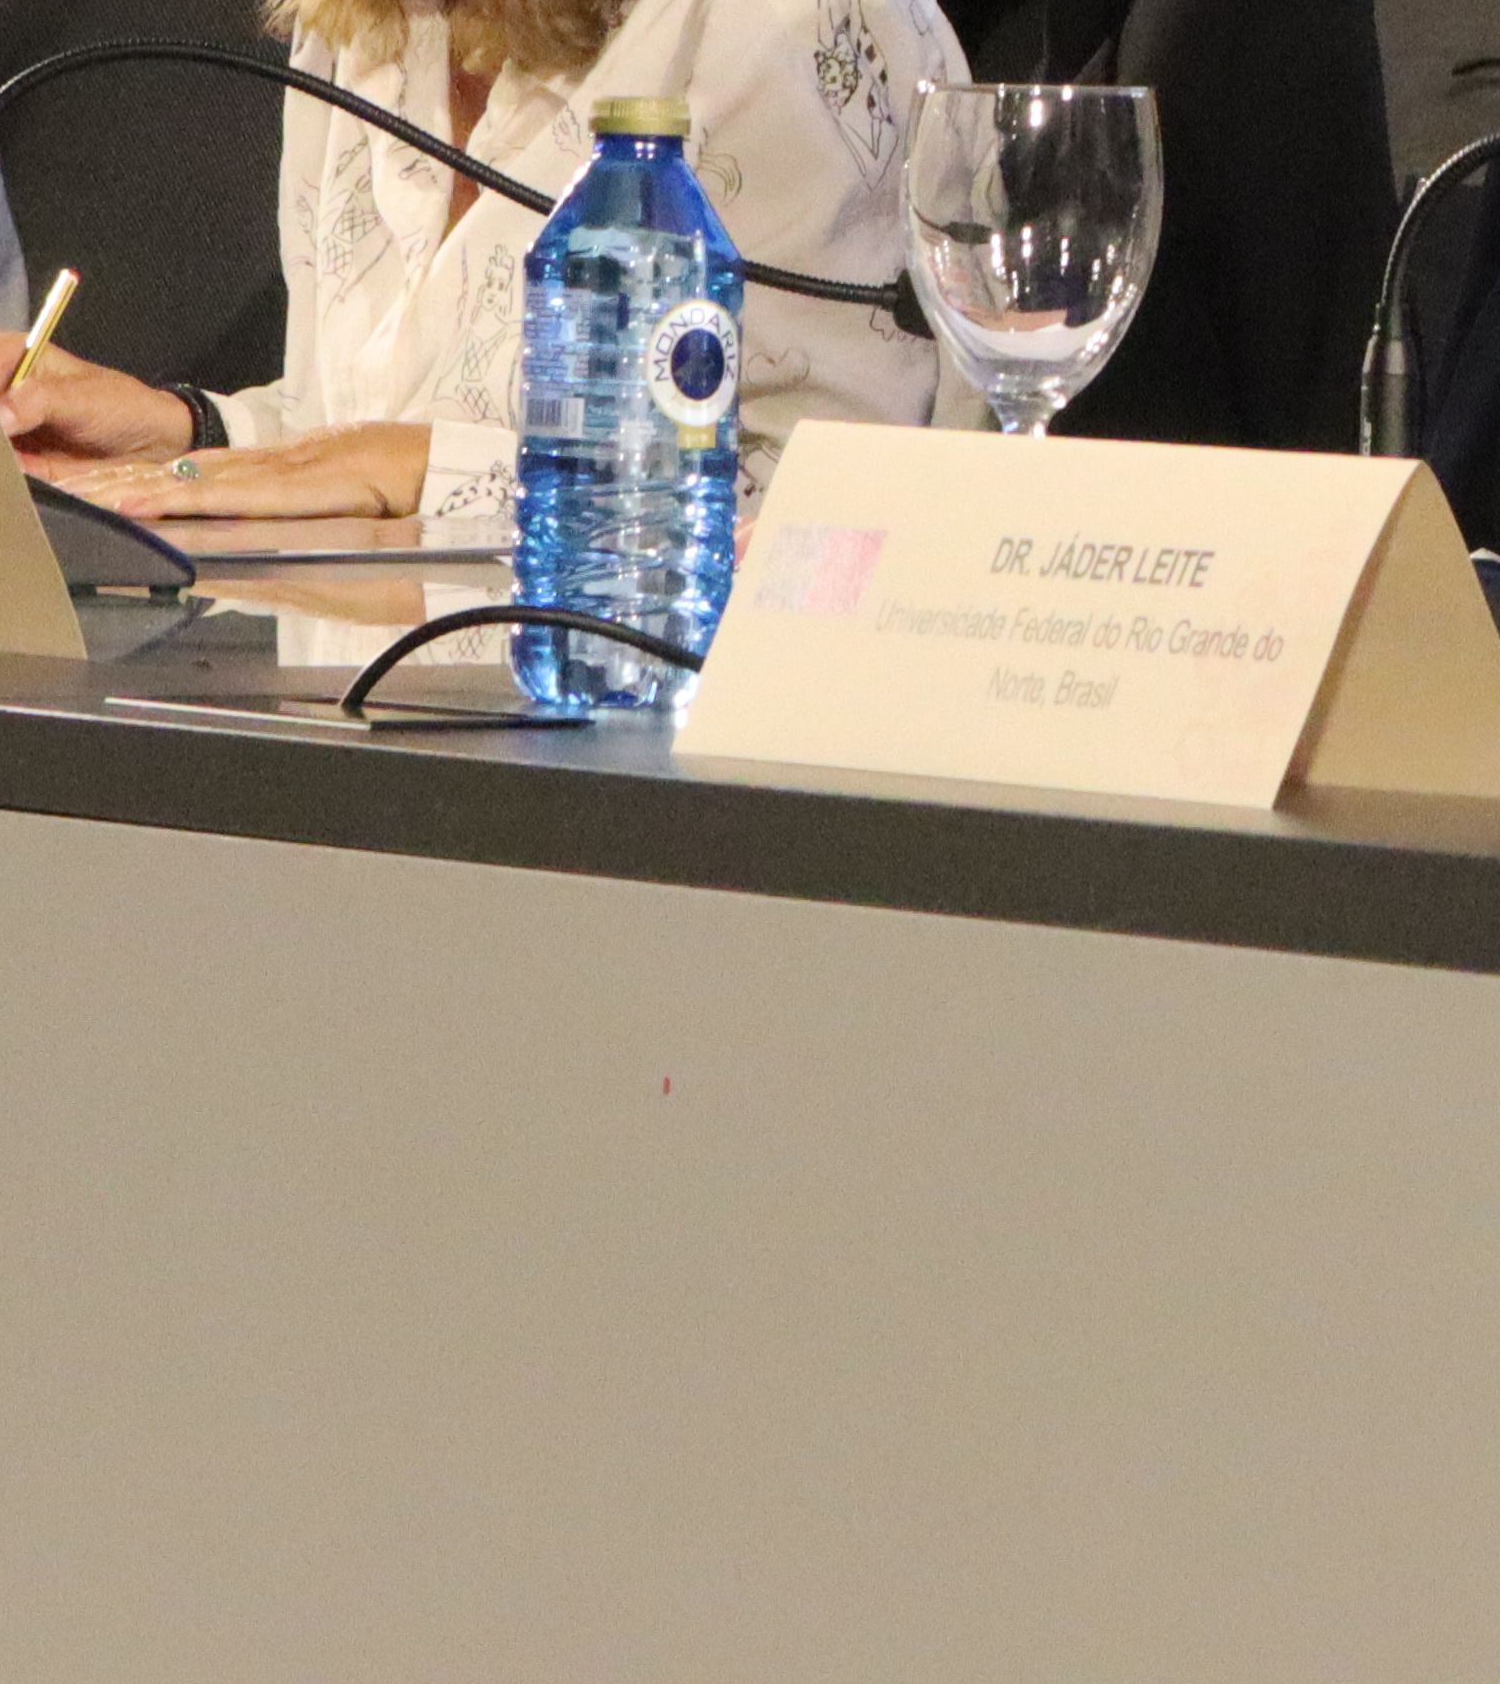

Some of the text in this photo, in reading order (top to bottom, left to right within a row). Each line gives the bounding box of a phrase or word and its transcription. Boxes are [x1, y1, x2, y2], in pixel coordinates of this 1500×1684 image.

[653, 308, 736, 382] MONDARIZ
[990, 532, 1215, 589] DR. JÁDER LEITE
[875, 598, 1284, 662] Universidade Federal do Rio Grande do
[987, 666, 1120, 708] Norte, Brasil
